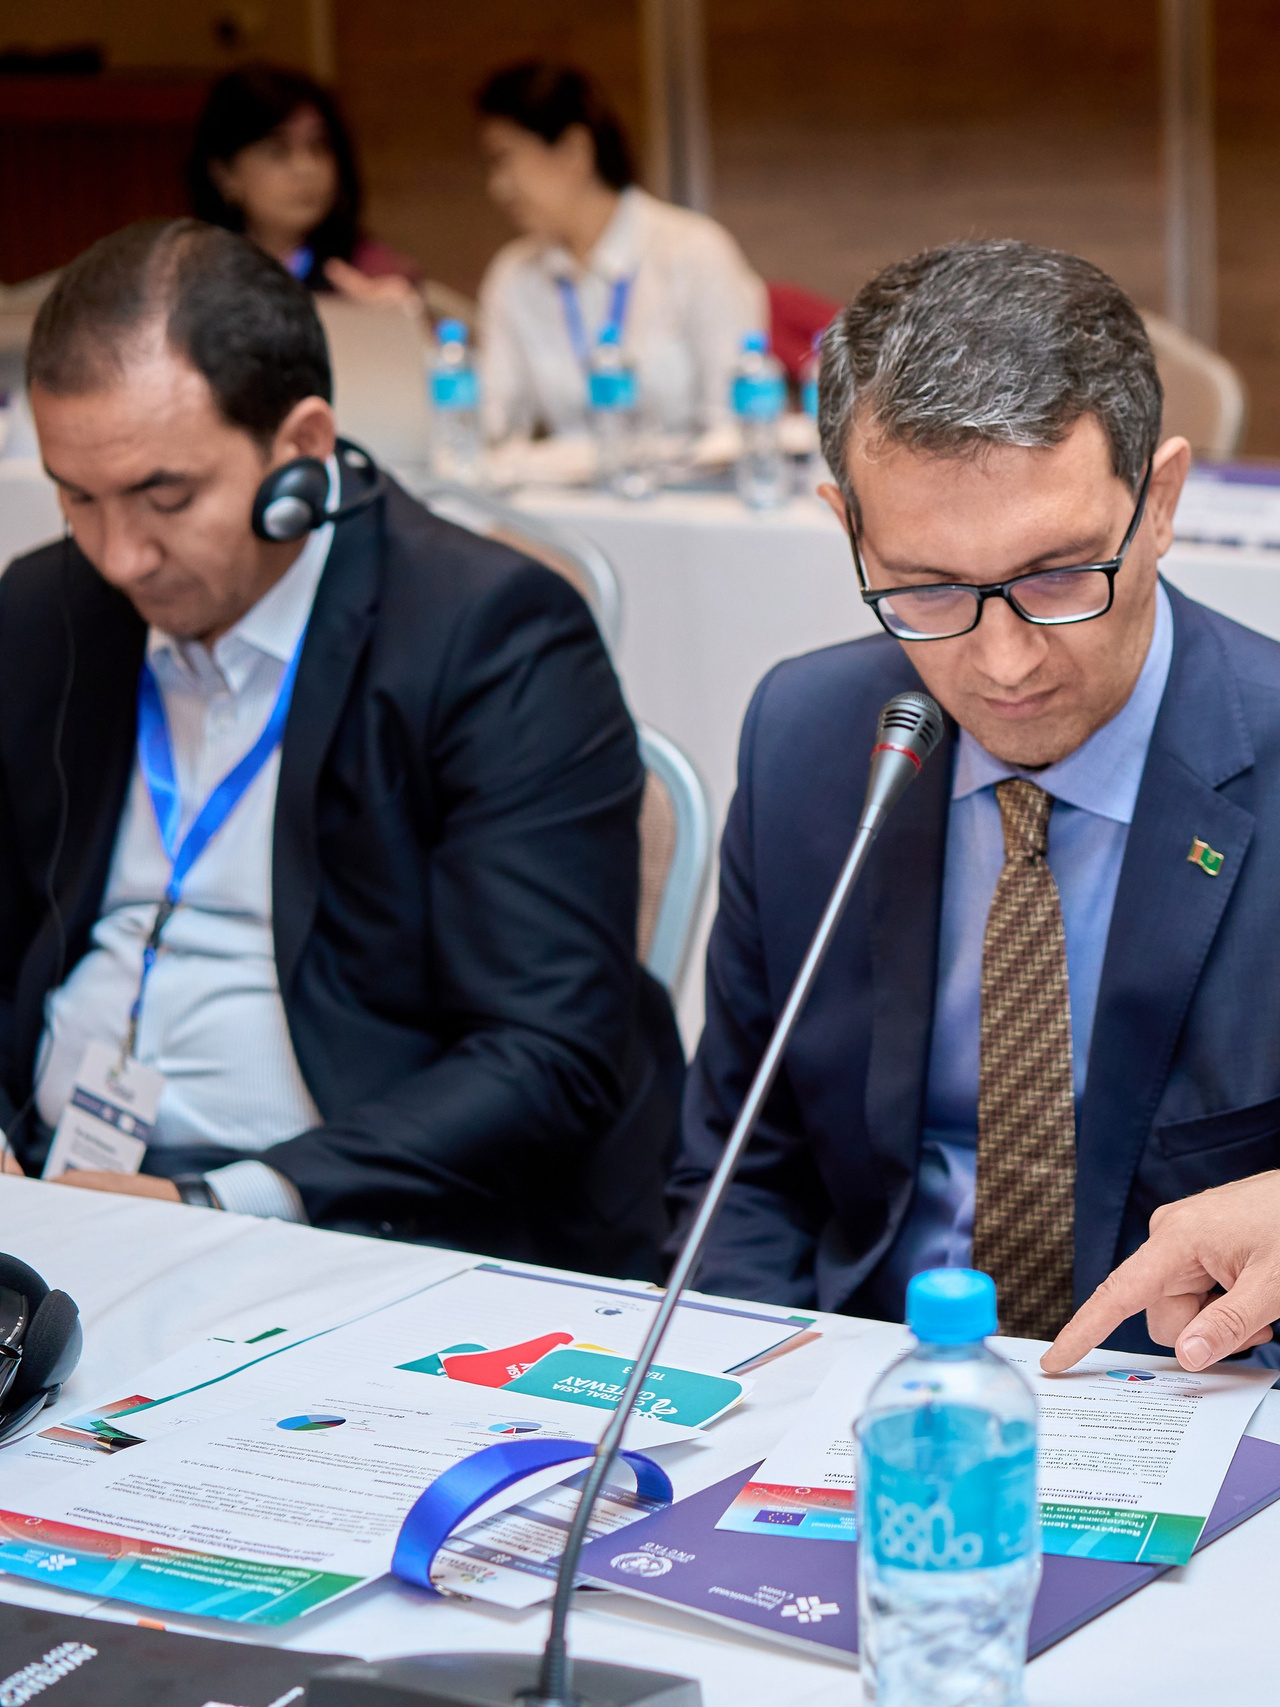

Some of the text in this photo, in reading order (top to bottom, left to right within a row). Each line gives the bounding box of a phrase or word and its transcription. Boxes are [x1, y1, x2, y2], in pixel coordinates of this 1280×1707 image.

[621, 1365, 665, 1381] TEA 3
[551, 1382, 584, 1395] ASIA
[1056, 1505, 1110, 1516] торговлю
[1113, 1511, 1148, 1520] через
[1078, 1515, 1144, 1528] Поддержка
[1070, 1522, 1140, 1536] Ready4Trade
[644, 1540, 695, 1560] UNCTAD
[706, 1585, 777, 1611] International
